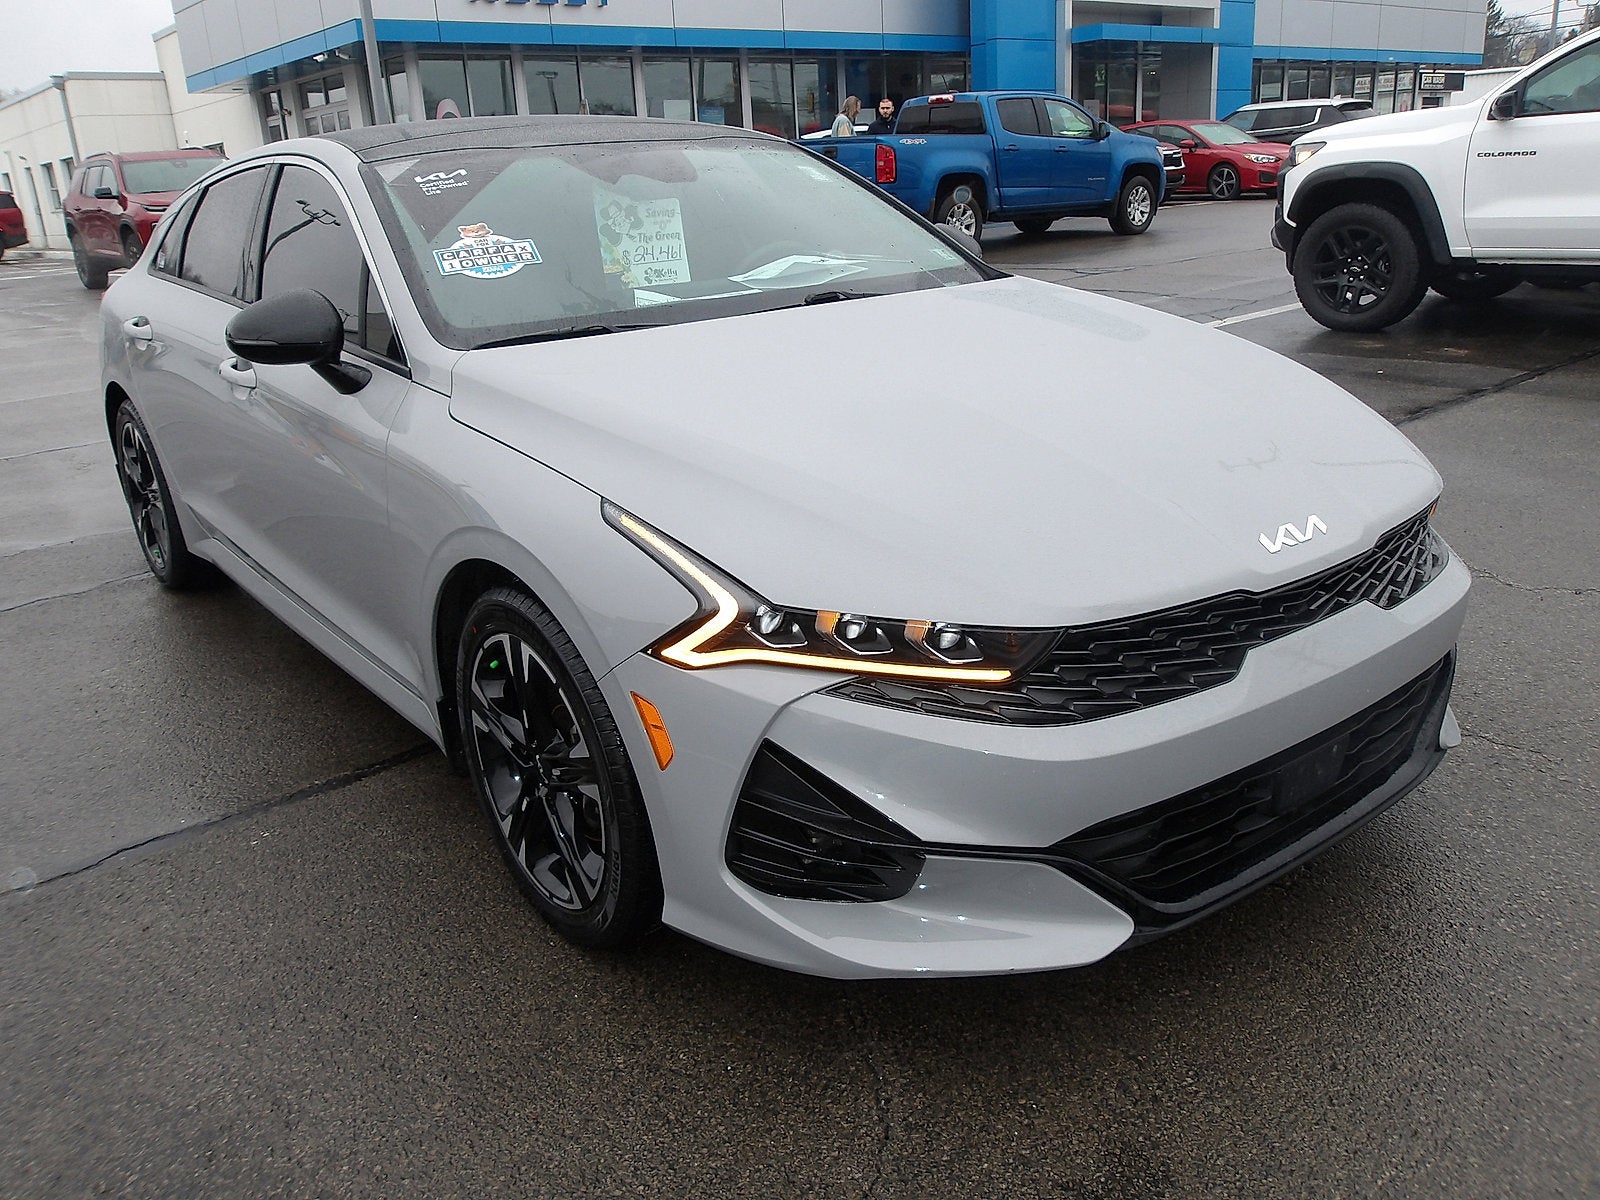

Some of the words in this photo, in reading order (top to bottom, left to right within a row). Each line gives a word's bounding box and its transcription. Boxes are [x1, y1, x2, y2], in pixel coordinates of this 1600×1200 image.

[420, 179, 454, 188] Certified
[636, 232, 653, 244] The
[655, 231, 682, 240] Green
[440, 244, 530, 261] CARFAX
[447, 261, 456, 270] 1
[460, 251, 536, 271] OWNER
